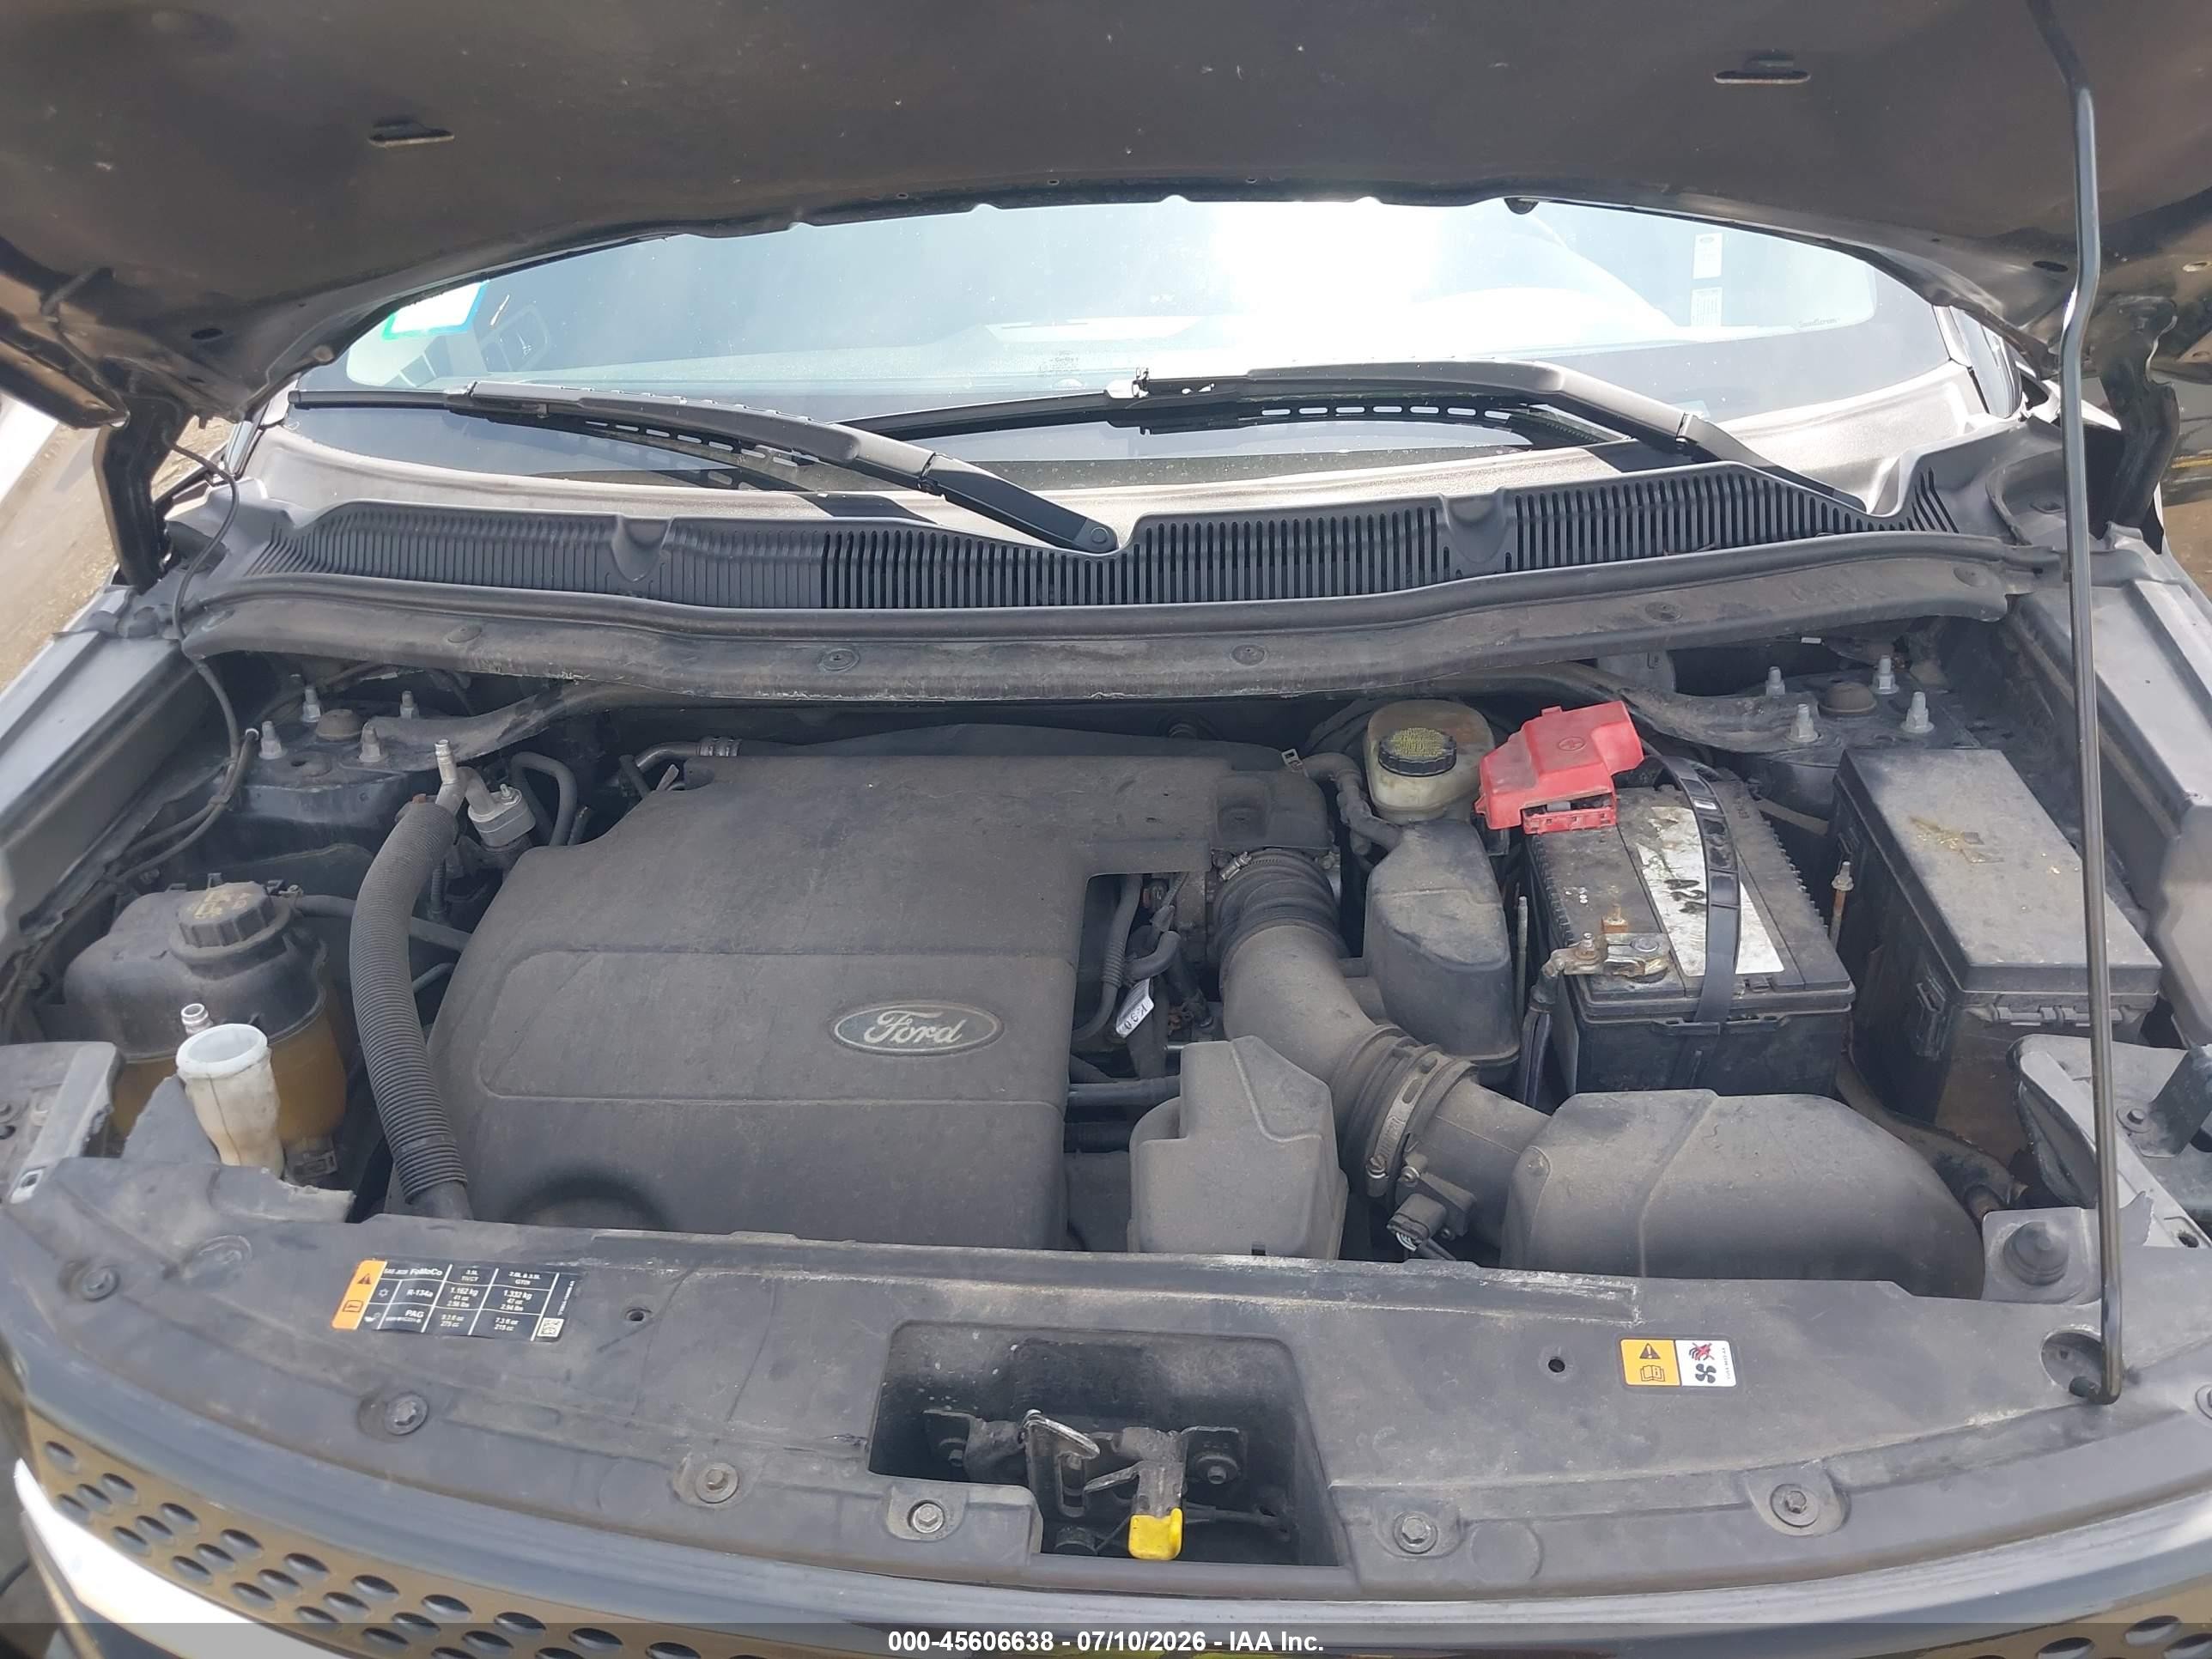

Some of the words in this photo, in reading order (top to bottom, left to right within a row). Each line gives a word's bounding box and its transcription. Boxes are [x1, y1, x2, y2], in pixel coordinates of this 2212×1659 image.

[863, 1010, 967, 1044] Ford
[410, 1267, 443, 1276] FoMoCo
[406, 1289, 434, 1298] R-134a
[469, 1288, 479, 1297] kg
[522, 1291, 532, 1300] kg
[405, 1310, 424, 1318] PAG
